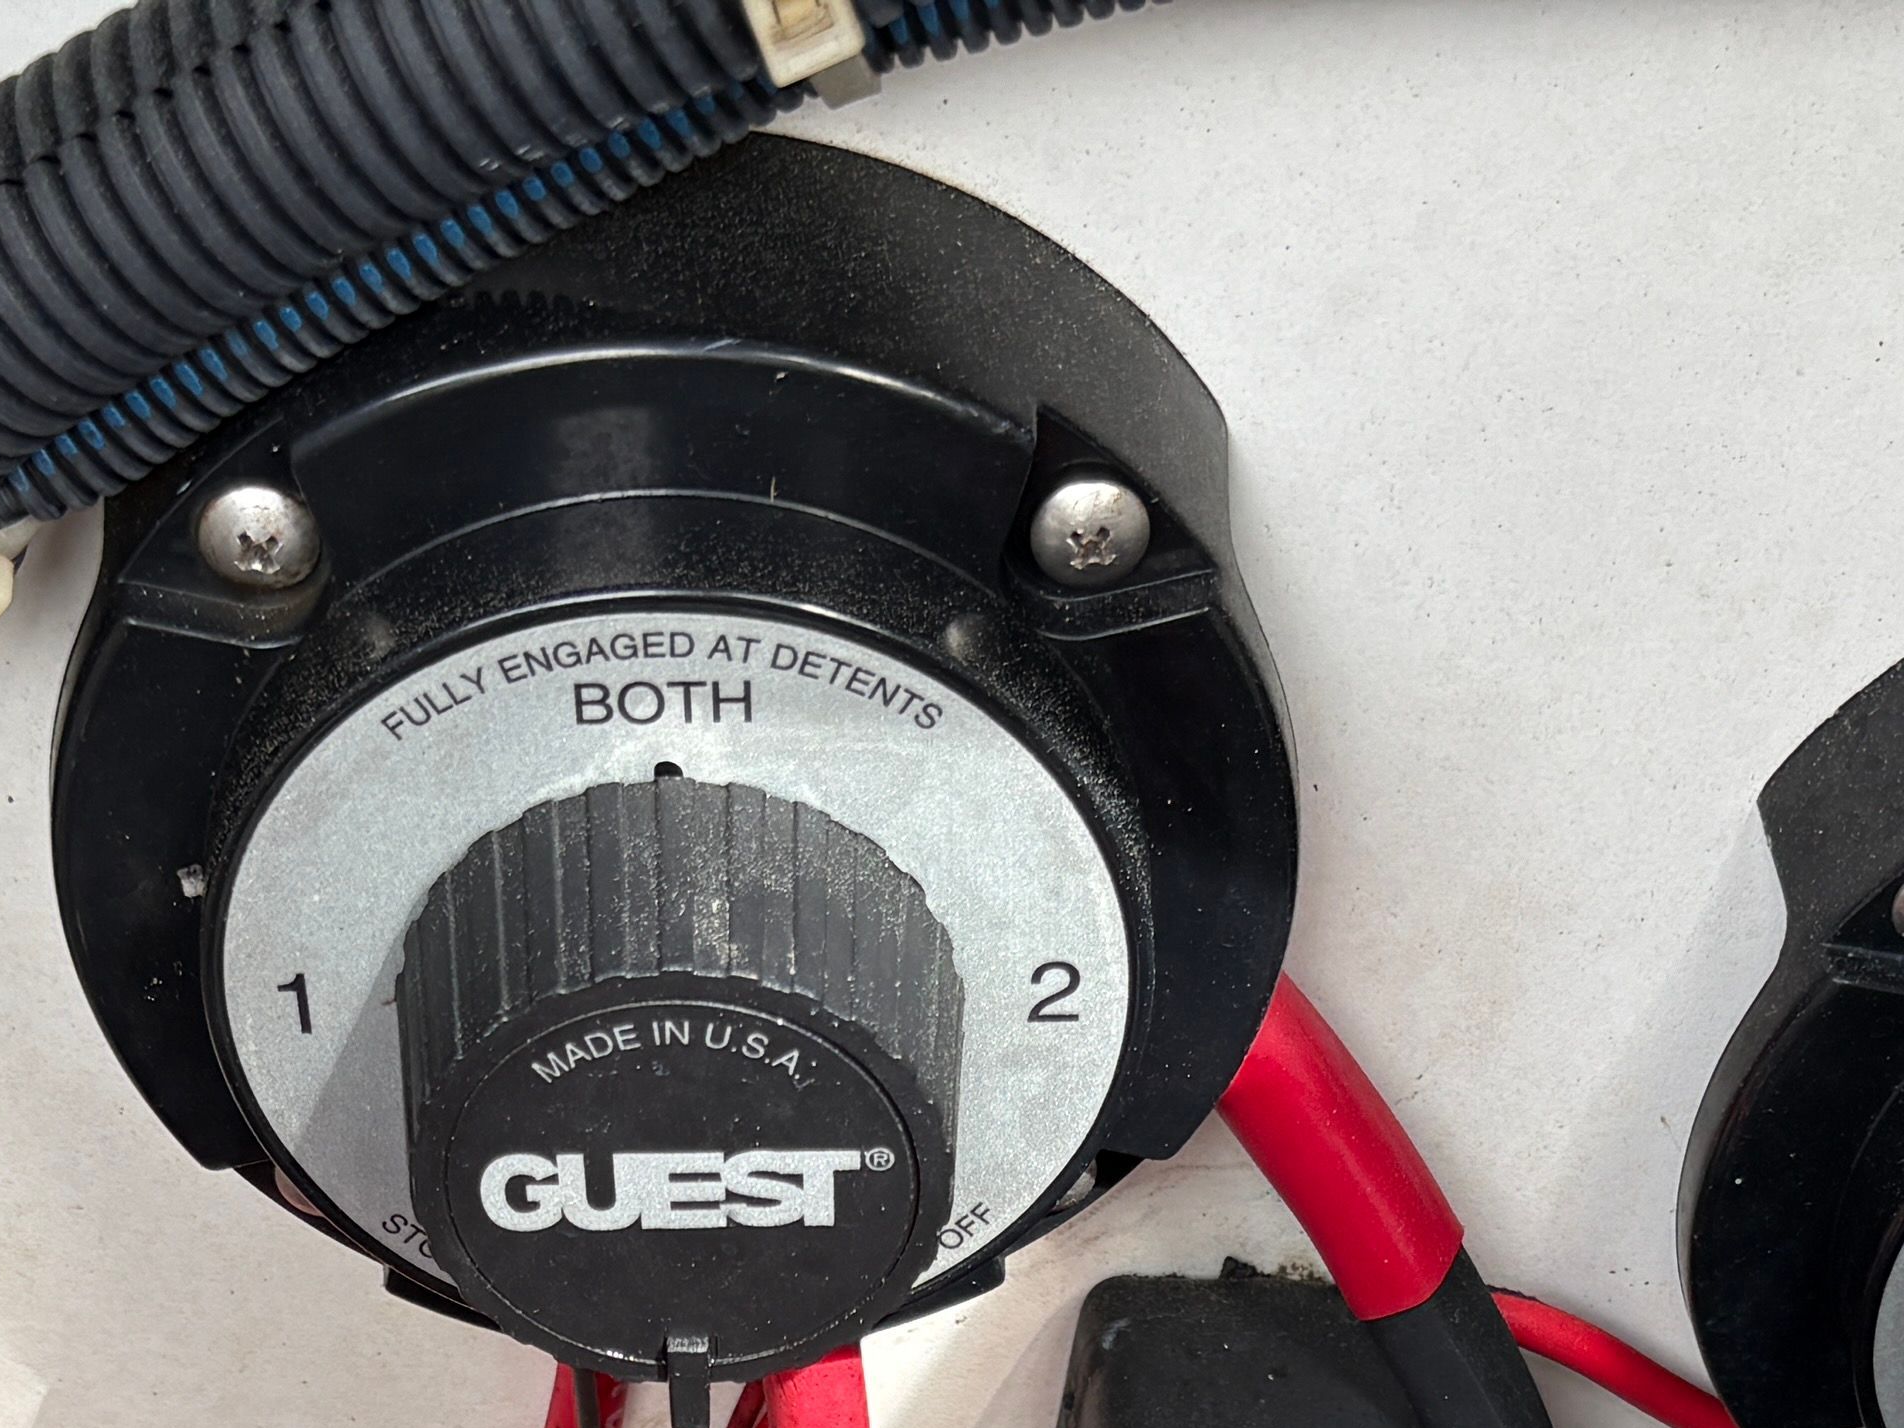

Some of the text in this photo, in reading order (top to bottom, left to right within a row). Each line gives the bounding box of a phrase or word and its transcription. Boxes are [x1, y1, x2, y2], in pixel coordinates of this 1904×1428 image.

[381, 630, 945, 741] FULLY ENGAGED AT DETENTS
[573, 681, 754, 725] BOTH
[277, 973, 309, 1034] 1
[1028, 961, 1081, 1024] 2
[532, 1018, 644, 1085] MADE
[652, 1021, 692, 1048] IN
[382, 1203, 993, 1260] STO OFF
